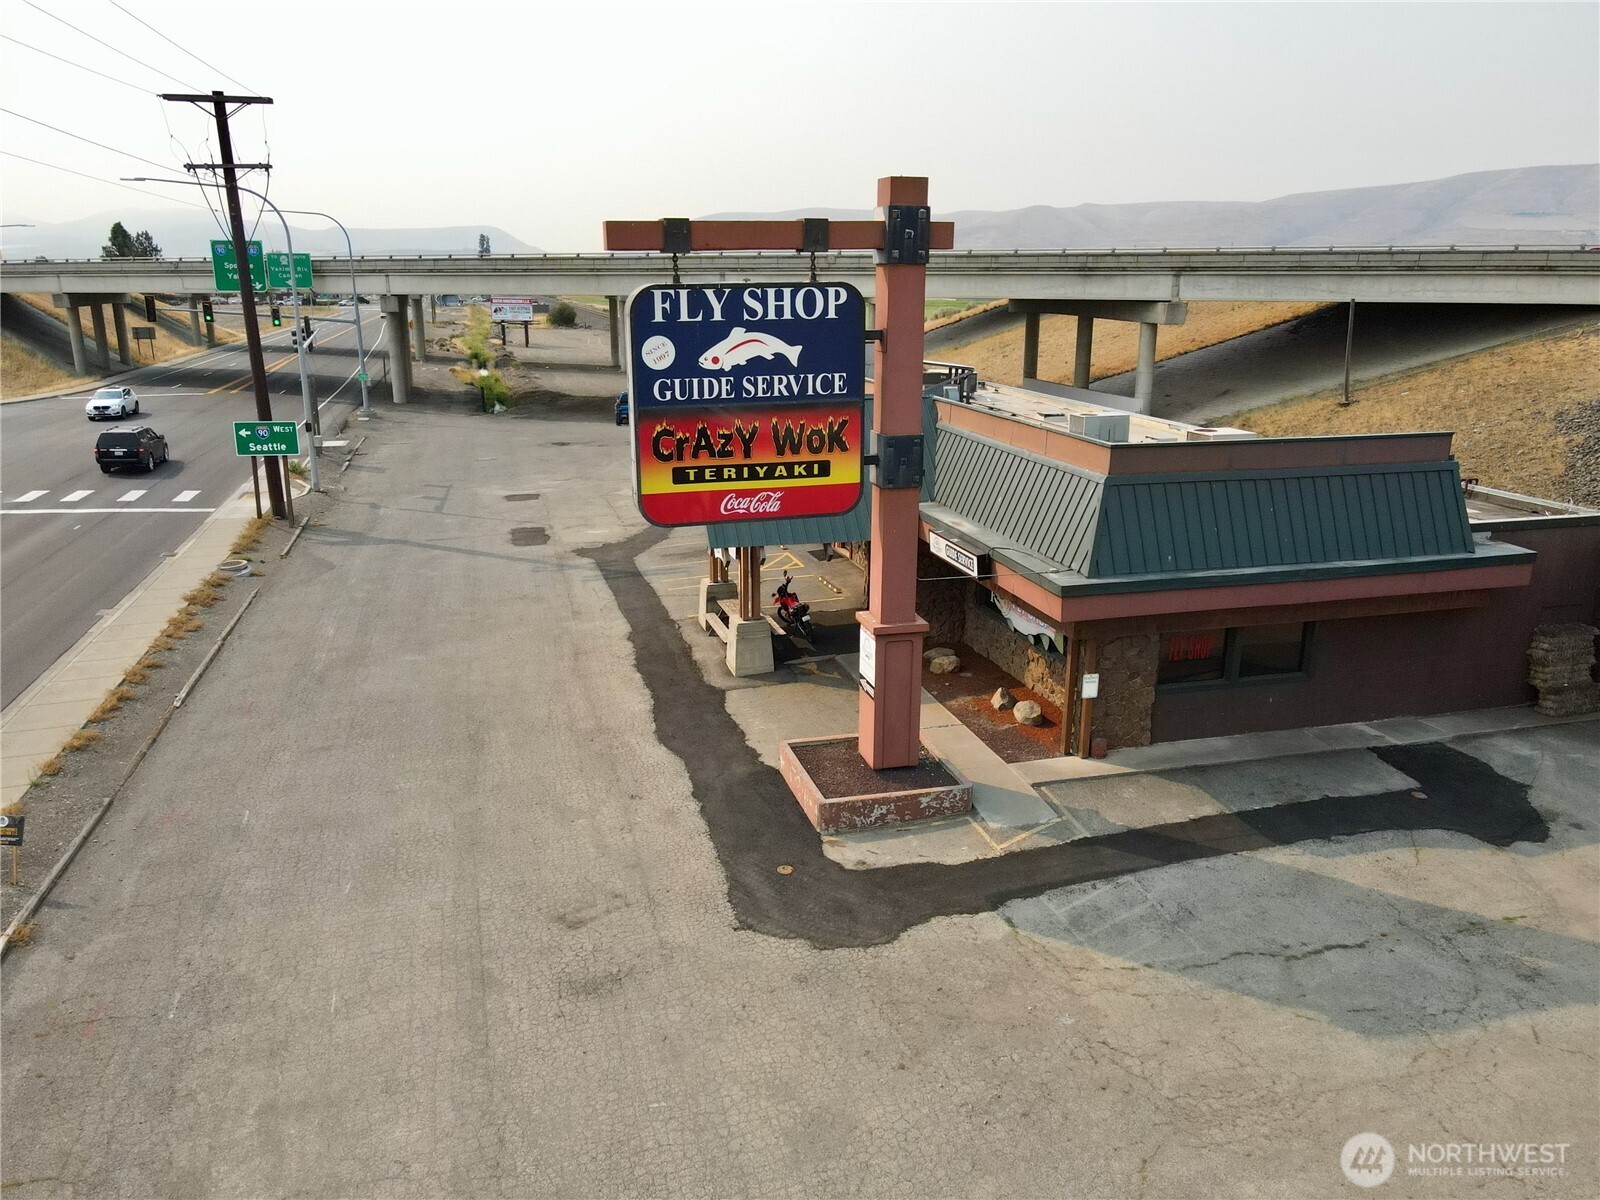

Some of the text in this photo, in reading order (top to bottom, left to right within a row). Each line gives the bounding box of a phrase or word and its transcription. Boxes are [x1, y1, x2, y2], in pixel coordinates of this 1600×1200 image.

[224, 262, 254, 270] Spoe
[651, 286, 848, 323] FLY SHOP
[645, 341, 668, 357] SINCE
[653, 372, 848, 401] GUIDE SERVICE
[257, 425, 293, 437] 90 WEST
[249, 442, 287, 451] Seattle
[685, 463, 819, 481] TERIYAKI
[720, 491, 784, 515] Coca-Cola
[957, 551, 974, 570] SERVICE
